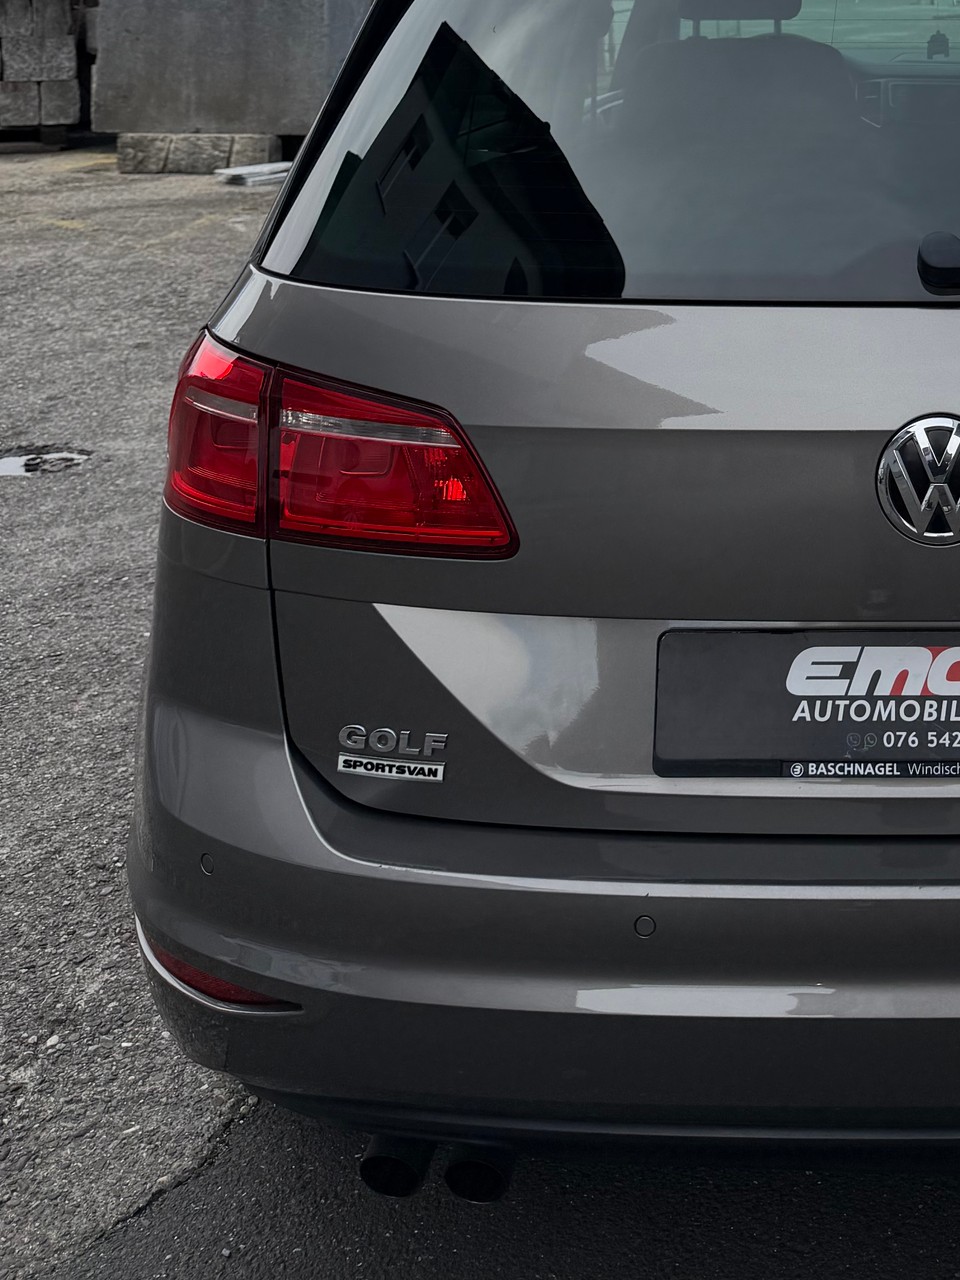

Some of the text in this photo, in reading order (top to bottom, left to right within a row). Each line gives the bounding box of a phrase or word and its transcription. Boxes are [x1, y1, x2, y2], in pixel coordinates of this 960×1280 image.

[338, 724, 449, 756] GOLF
[882, 731, 919, 748] 076
[342, 759, 439, 778] SPORTSVAN
[808, 763, 901, 776] BASCHNAGEL
